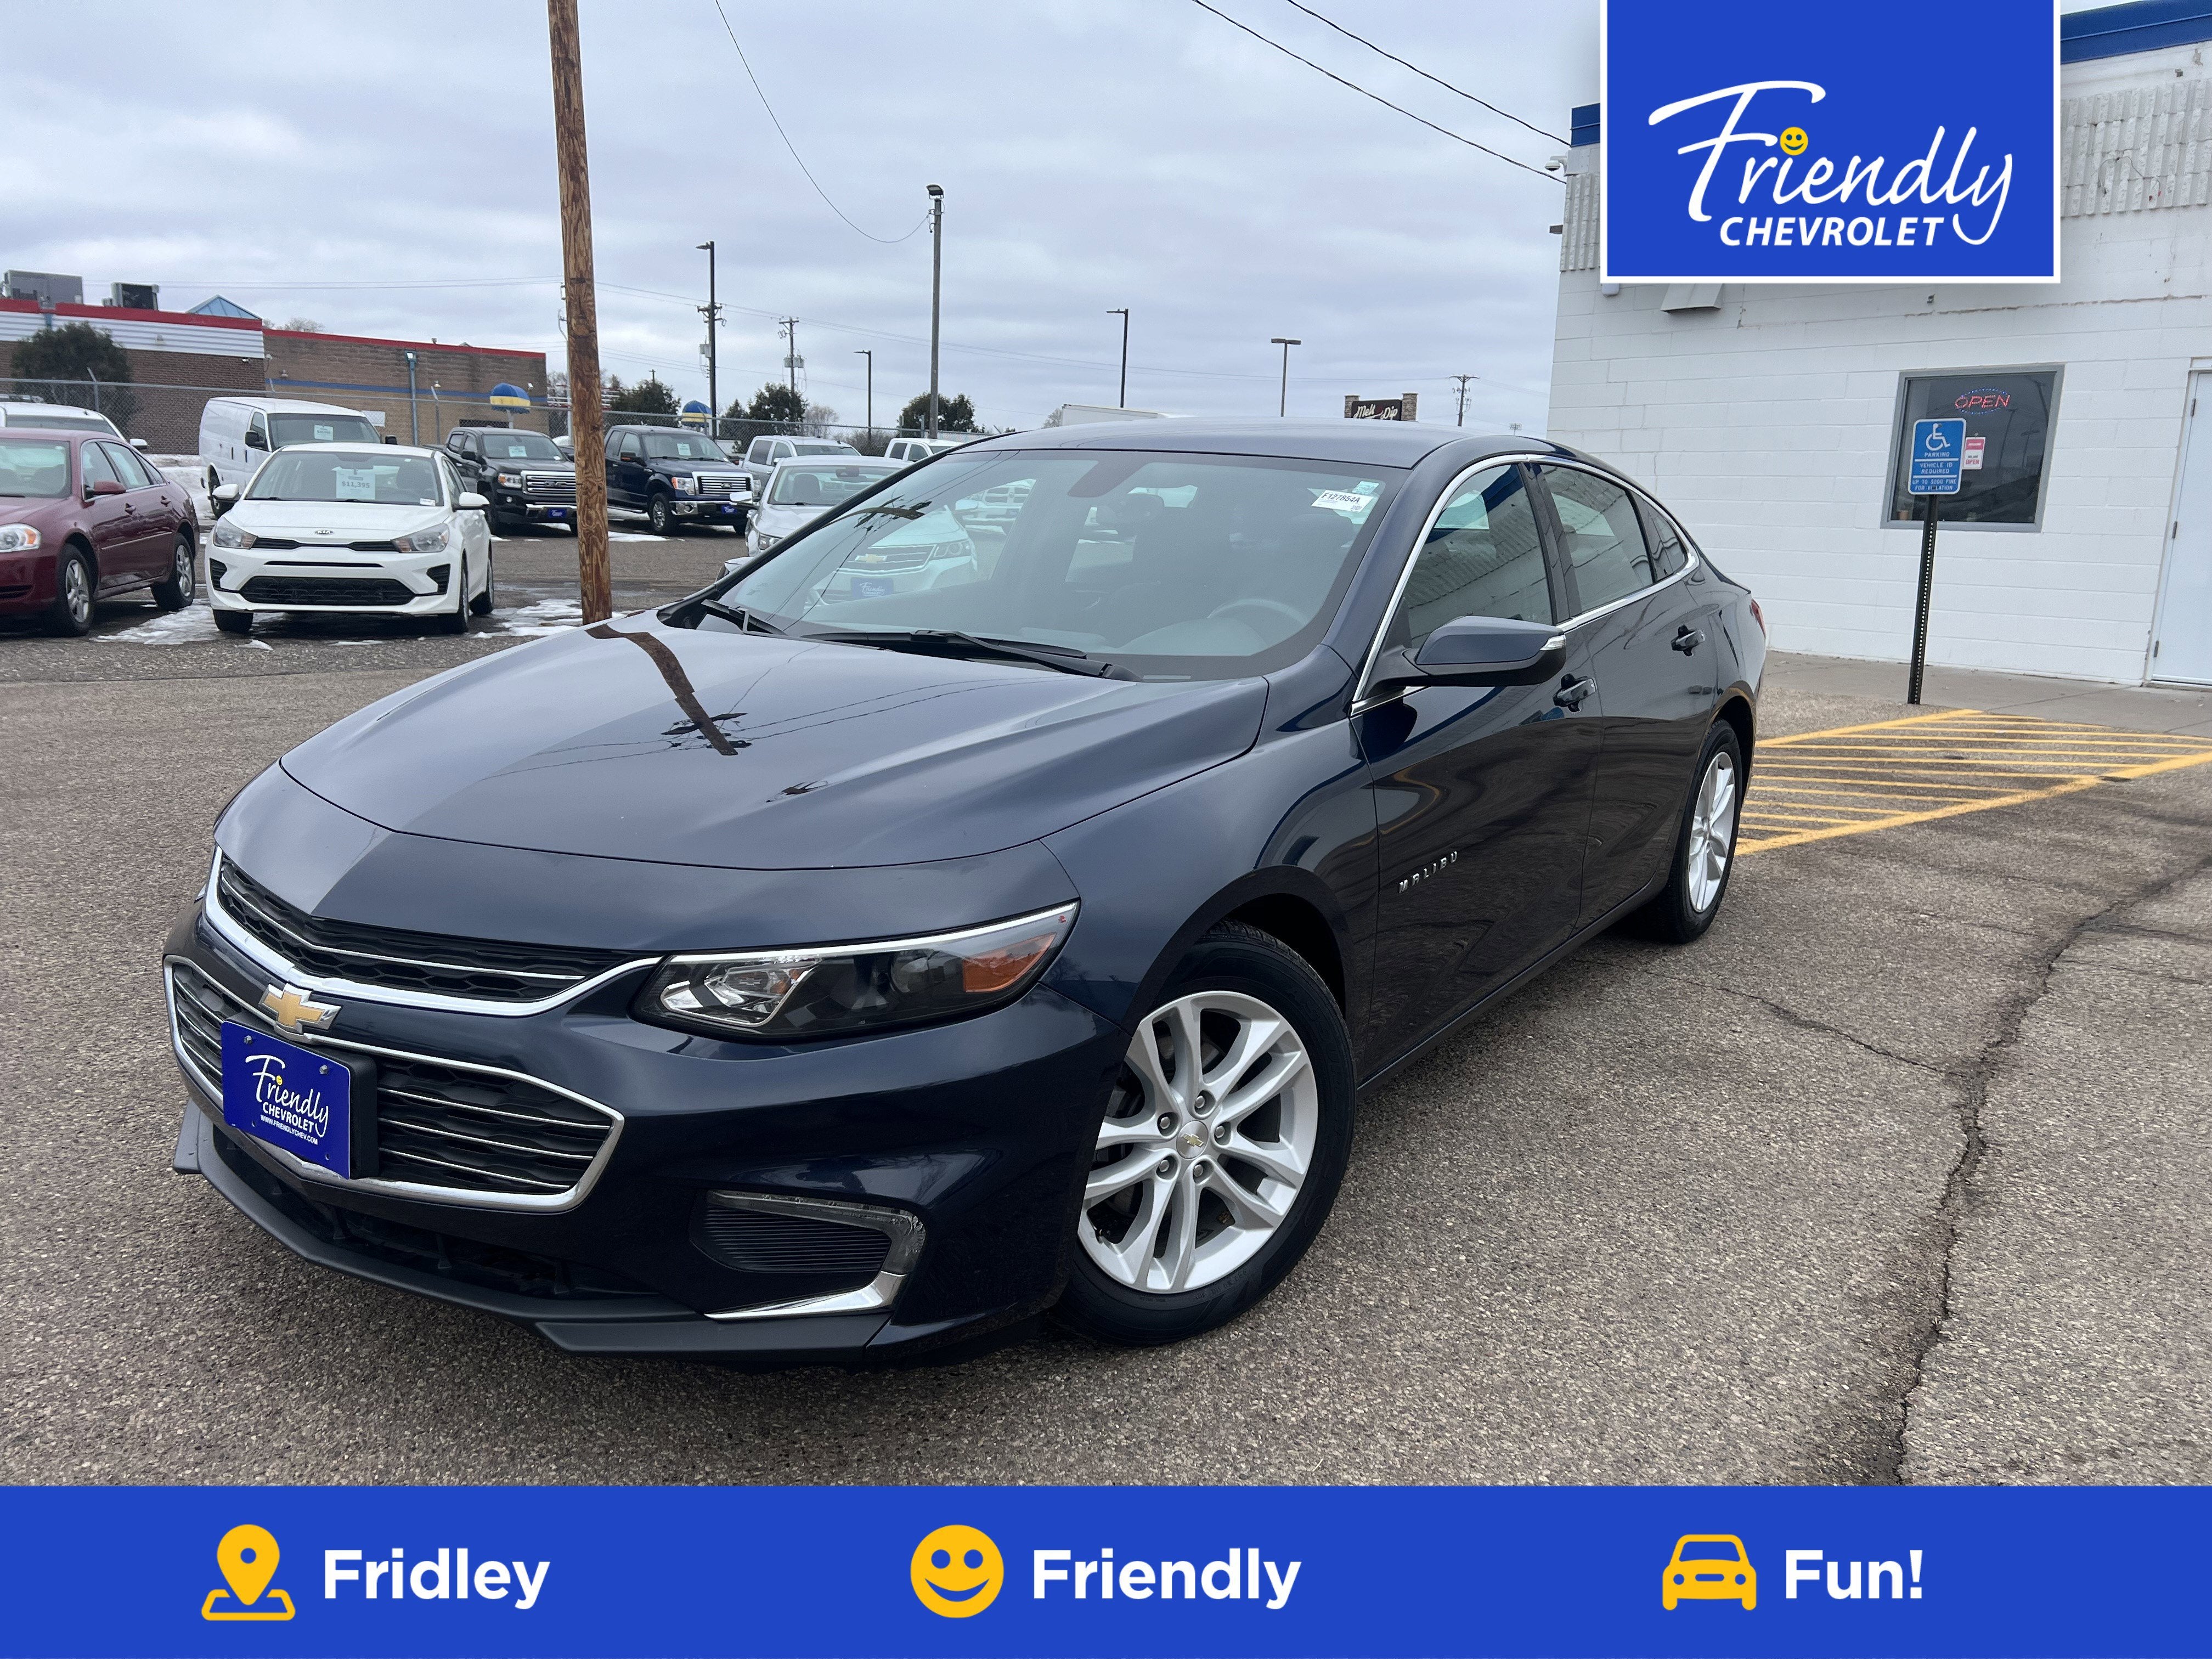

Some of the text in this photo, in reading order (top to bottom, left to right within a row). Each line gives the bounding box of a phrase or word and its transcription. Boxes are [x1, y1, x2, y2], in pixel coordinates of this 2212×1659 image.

[1380, 406, 1398, 420] Dip
[1955, 395, 2010, 409] OPEN
[1322, 493, 1361, 504] F127854A
[1398, 851, 1457, 894] MALIBU
[245, 1054, 329, 1138] Friendly
[259, 1114, 318, 1146] WWW.FRIENDLYCHEV.COM
[262, 1102, 314, 1133] CHEVROLET
